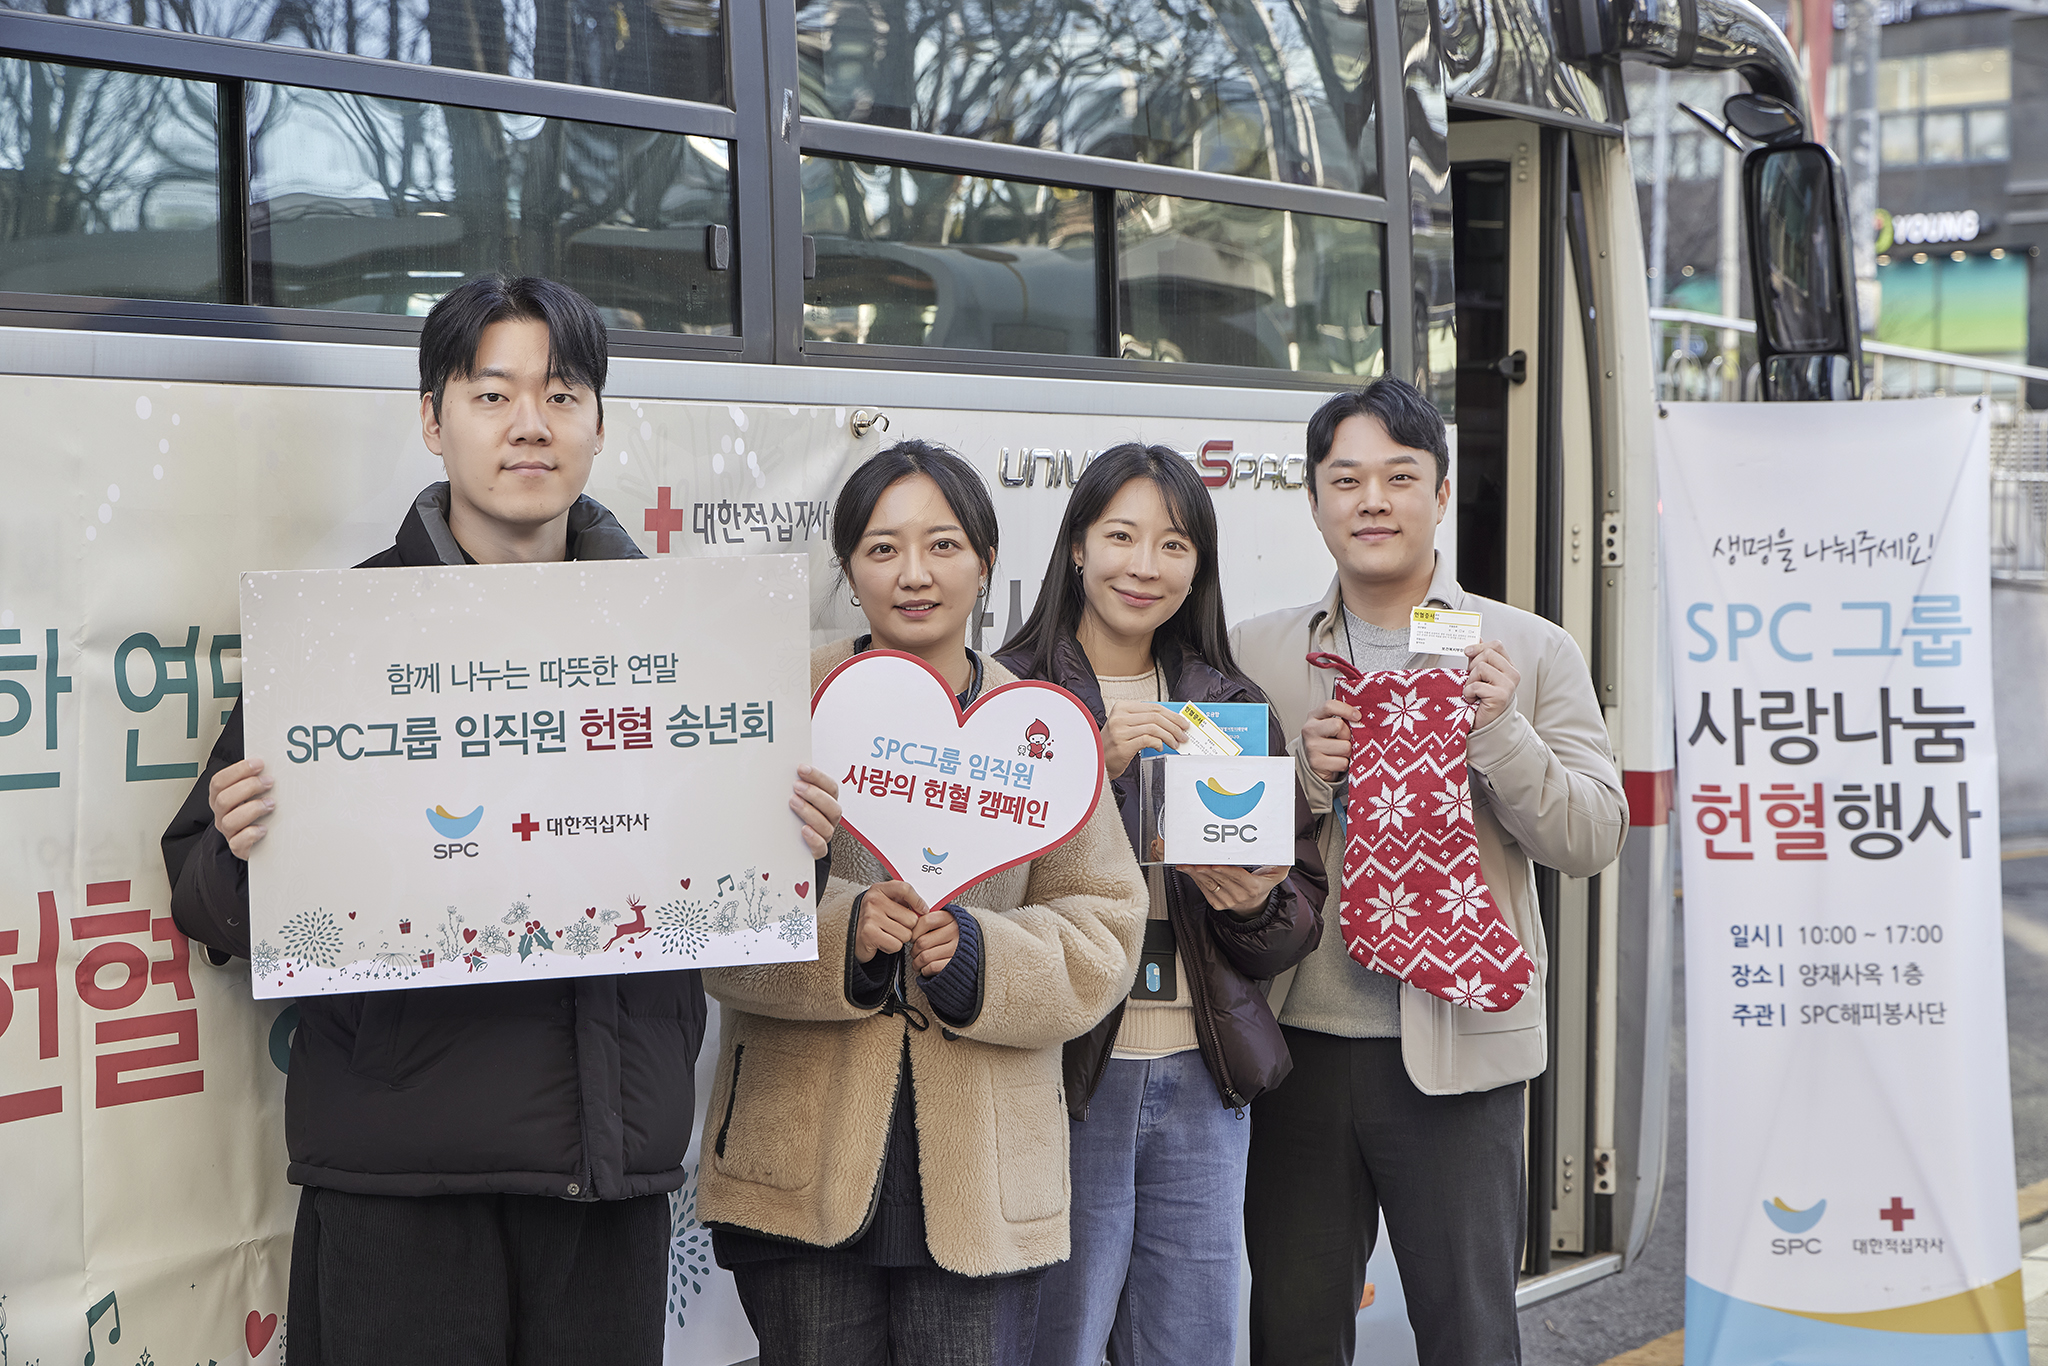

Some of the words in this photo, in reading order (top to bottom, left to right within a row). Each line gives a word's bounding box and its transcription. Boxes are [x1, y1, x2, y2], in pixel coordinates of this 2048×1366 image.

[1892, 209, 1980, 245] YOUNG
[1197, 439, 1309, 490] SPAC
[693, 499, 830, 544] 대한적십자사
[1711, 528, 1798, 572] 생명을
[1804, 530, 1934, 567] 나눠주세요!
[1686, 601, 1813, 663] SPC
[1832, 594, 1972, 668] 그룹
[387, 662, 441, 695] 함께
[451, 660, 530, 693] 나누는
[540, 655, 618, 688] 따뜻한
[627, 652, 679, 685] 연말
[286, 716, 442, 764] SPC그룹
[455, 710, 567, 758] 임직원
[580, 706, 653, 751] 헌혈
[666, 700, 774, 748] 송년회
[1688, 686, 1976, 766] 사랑나눔
[870, 736, 962, 775] SPC그룹
[968, 753, 1035, 790] 임직원
[841, 764, 917, 803] 사랑의
[924, 778, 972, 814] 헌혈
[978, 790, 1050, 828] 캠페인
[546, 813, 650, 836] 대한적십자사
[1203, 824, 1258, 843] SPC
[1692, 781, 1982, 861] 헌혈행사
[433, 842, 479, 859] SPC
[921, 864, 943, 875] SPC
[1799, 925, 1857, 944] 10:00
[1885, 924, 1944, 944] 17:00
[1799, 962, 1884, 987] 양재사옥
[1891, 962, 1925, 986] 1층
[1800, 1001, 1948, 1026] SPC해피봉사단
[1770, 1238, 1823, 1255] SPC
[1853, 1237, 1945, 1255] 대한적십자사
